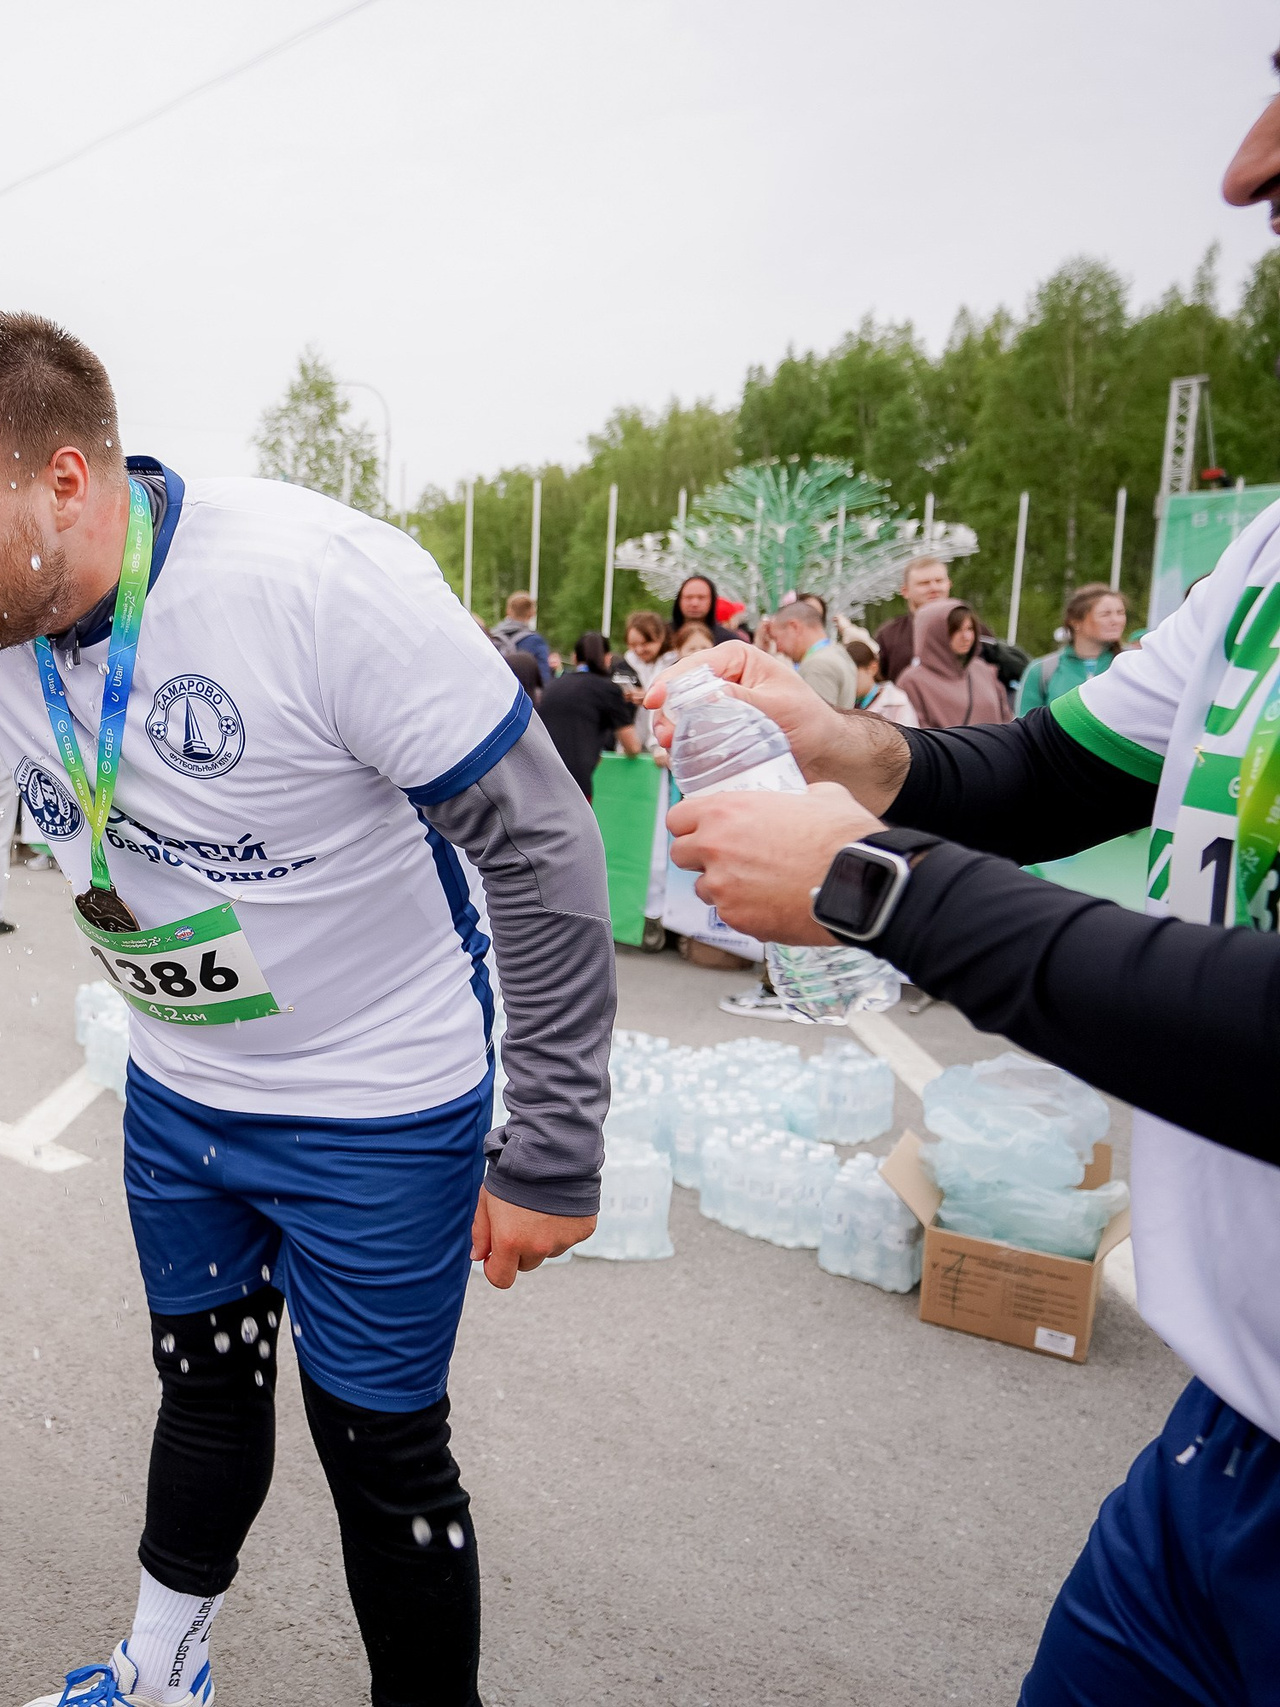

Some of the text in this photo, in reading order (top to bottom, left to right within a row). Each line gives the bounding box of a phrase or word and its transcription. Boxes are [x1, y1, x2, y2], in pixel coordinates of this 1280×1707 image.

[131, 553, 141, 574] 185
[46, 672, 58, 696] Utair
[112, 663, 125, 688] Utair
[157, 680, 223, 711] САМАРОВО
[62, 735, 76, 766] СБЕР
[104, 727, 115, 759] СБЕР
[169, 750, 233, 773] ФУТБОЛЬНЫЙ КЛУБ
[75, 777, 86, 797] 185
[34, 816, 73, 835] САРЕЙ
[96, 806, 107, 828] 185
[89, 945, 240, 998] 1386
